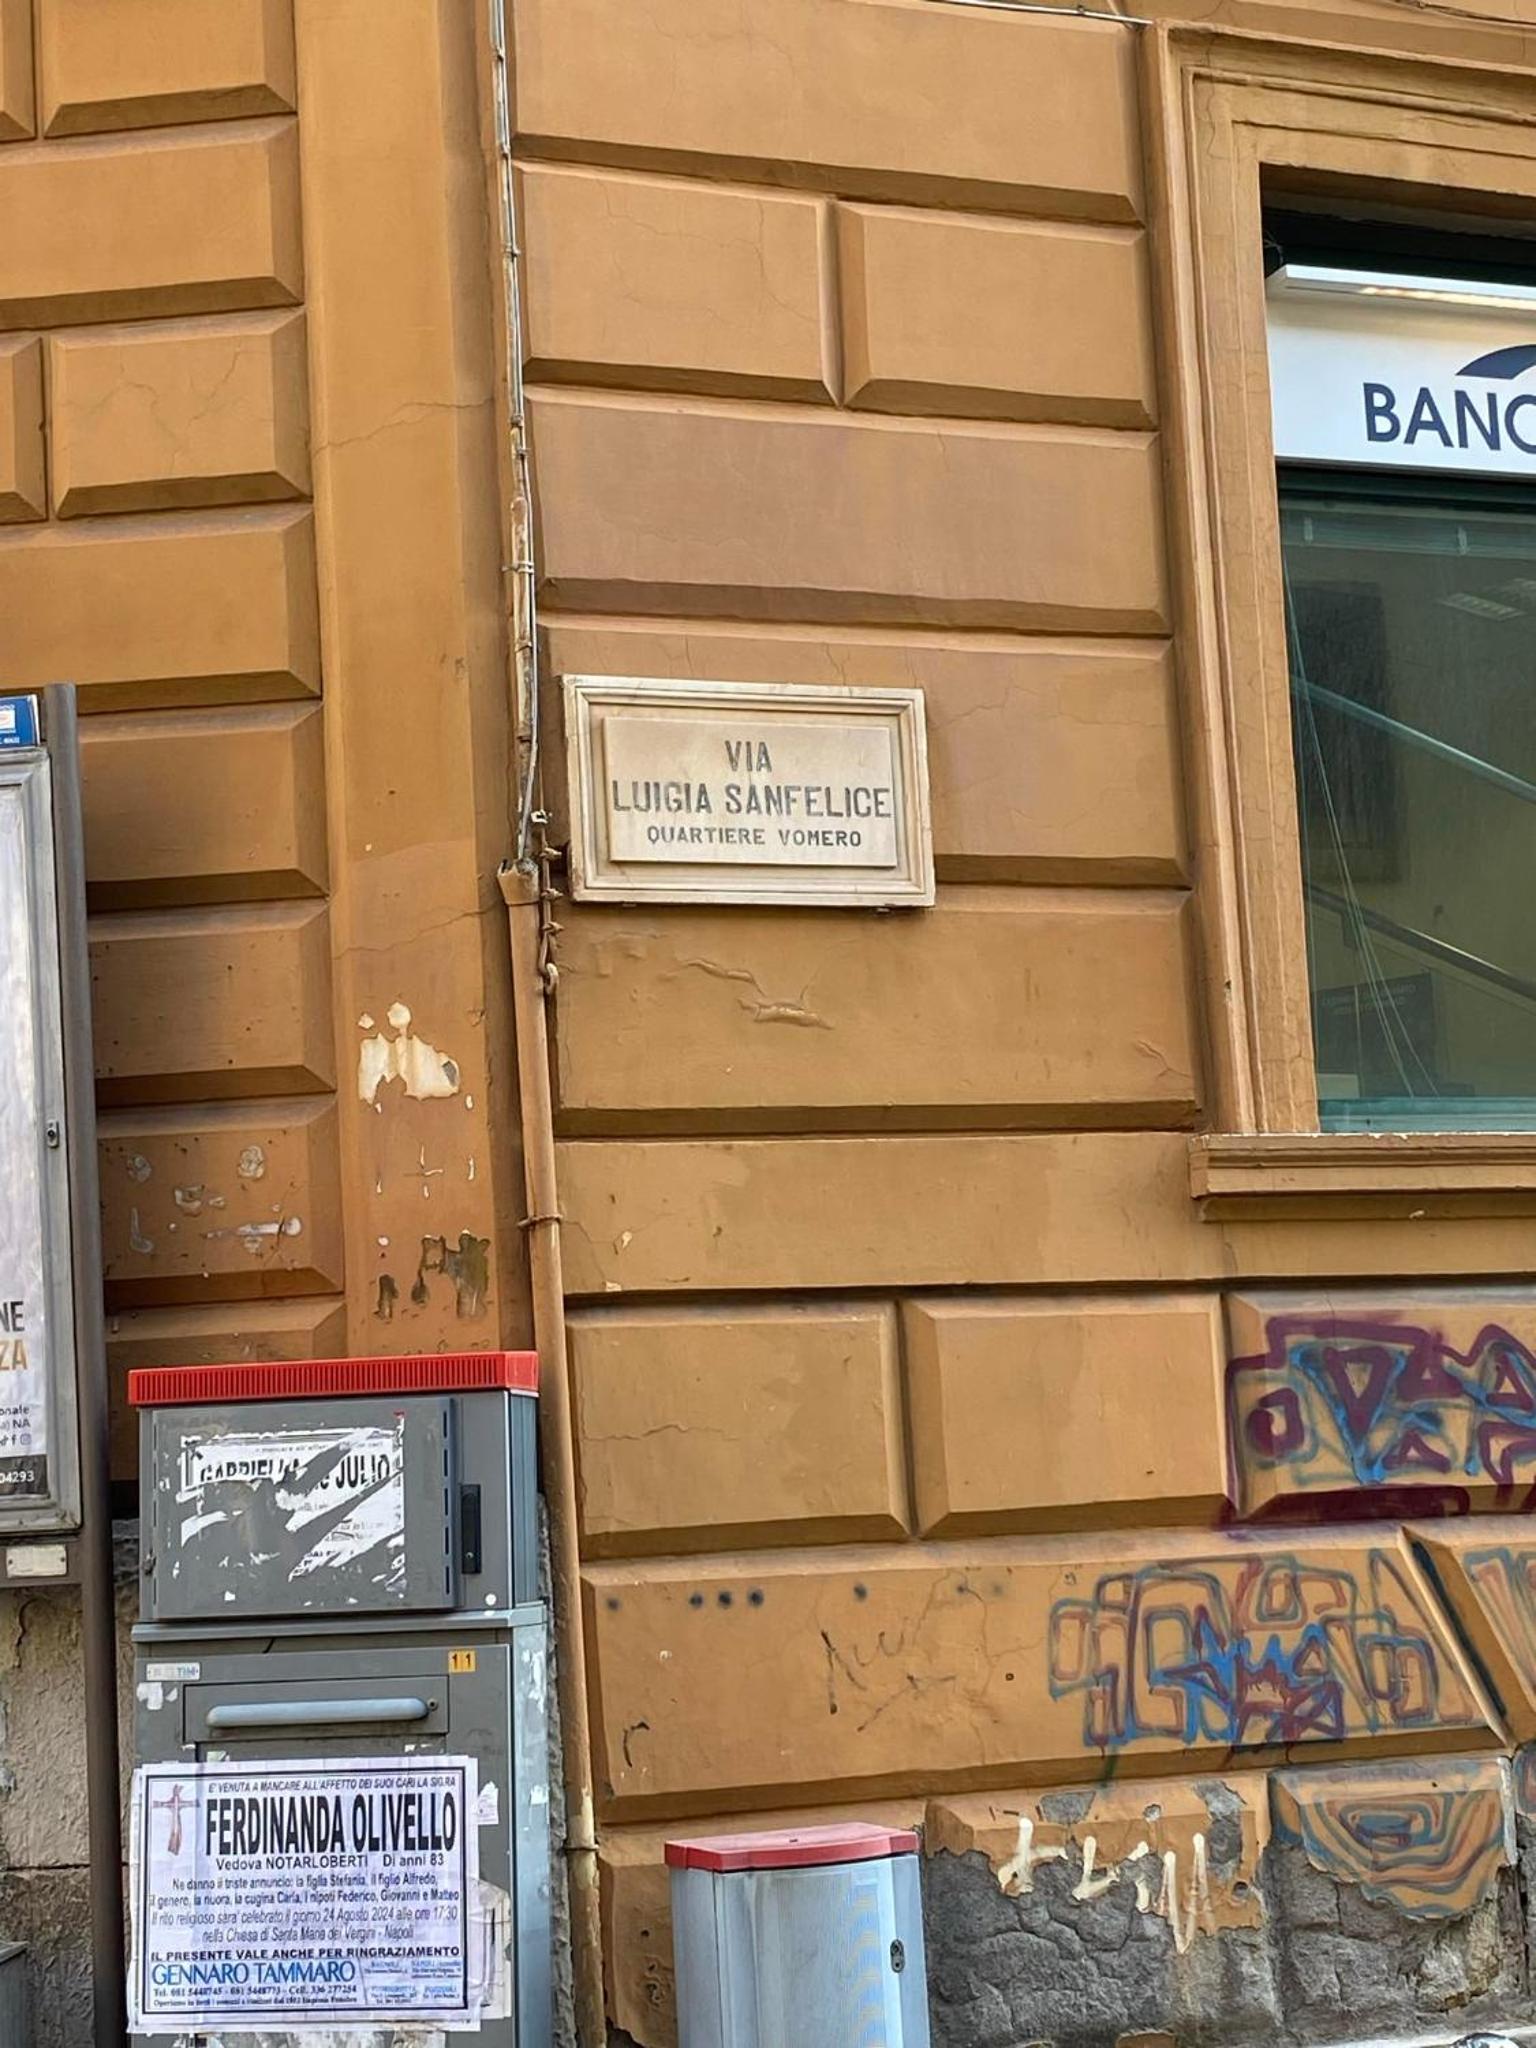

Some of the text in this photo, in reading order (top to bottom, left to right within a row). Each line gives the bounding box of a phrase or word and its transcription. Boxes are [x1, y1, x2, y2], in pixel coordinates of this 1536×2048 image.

[725, 740, 773, 772] VIA
[612, 780, 892, 818] LUIGIA SANFELICE
[647, 826, 862, 848] QUARTIERE VOMERO
[13, 1419, 31, 1429] NA
[336, 1454, 390, 1489] JULIO
[219, 1781, 251, 1793] VENUTA
[252, 1782, 258, 1791] A
[261, 1779, 301, 1792] MANCARE
[206, 1791, 456, 1855] FERDINANDA OLIVELLO
[216, 1853, 444, 1871] Vedova NOTARLOBERTI Di anni 83
[187, 1878, 215, 1890] danno
[225, 1878, 248, 1889] triste
[306, 1874, 328, 1890] figlia
[378, 1872, 400, 1888] figlio
[244, 1892, 274, 1907] cugina
[310, 1890, 335, 1905] nipoti
[381, 1887, 420, 1901] Giovanni
[431, 1887, 459, 1900] Matteo
[176, 1912, 215, 1928] religioso
[241, 1909, 283, 1924] celebrato
[292, 1908, 321, 1926] giorno
[323, 1907, 334, 1922] 24
[337, 1907, 369, 1926] Agosto
[371, 1906, 393, 1921] 2024
[397, 1906, 412, 1920] alle
[414, 1908, 430, 1920] ore
[226, 1927, 259, 1942] Chiesa
[271, 1926, 299, 1941] Santa
[385, 1924, 414, 1942] Napoli
[151, 1946, 460, 1961] IL PRESENTE VALE ANCHE PER RINGRAZIAMENTO
[151, 1960, 356, 1986] GENNARO TAMMARO
